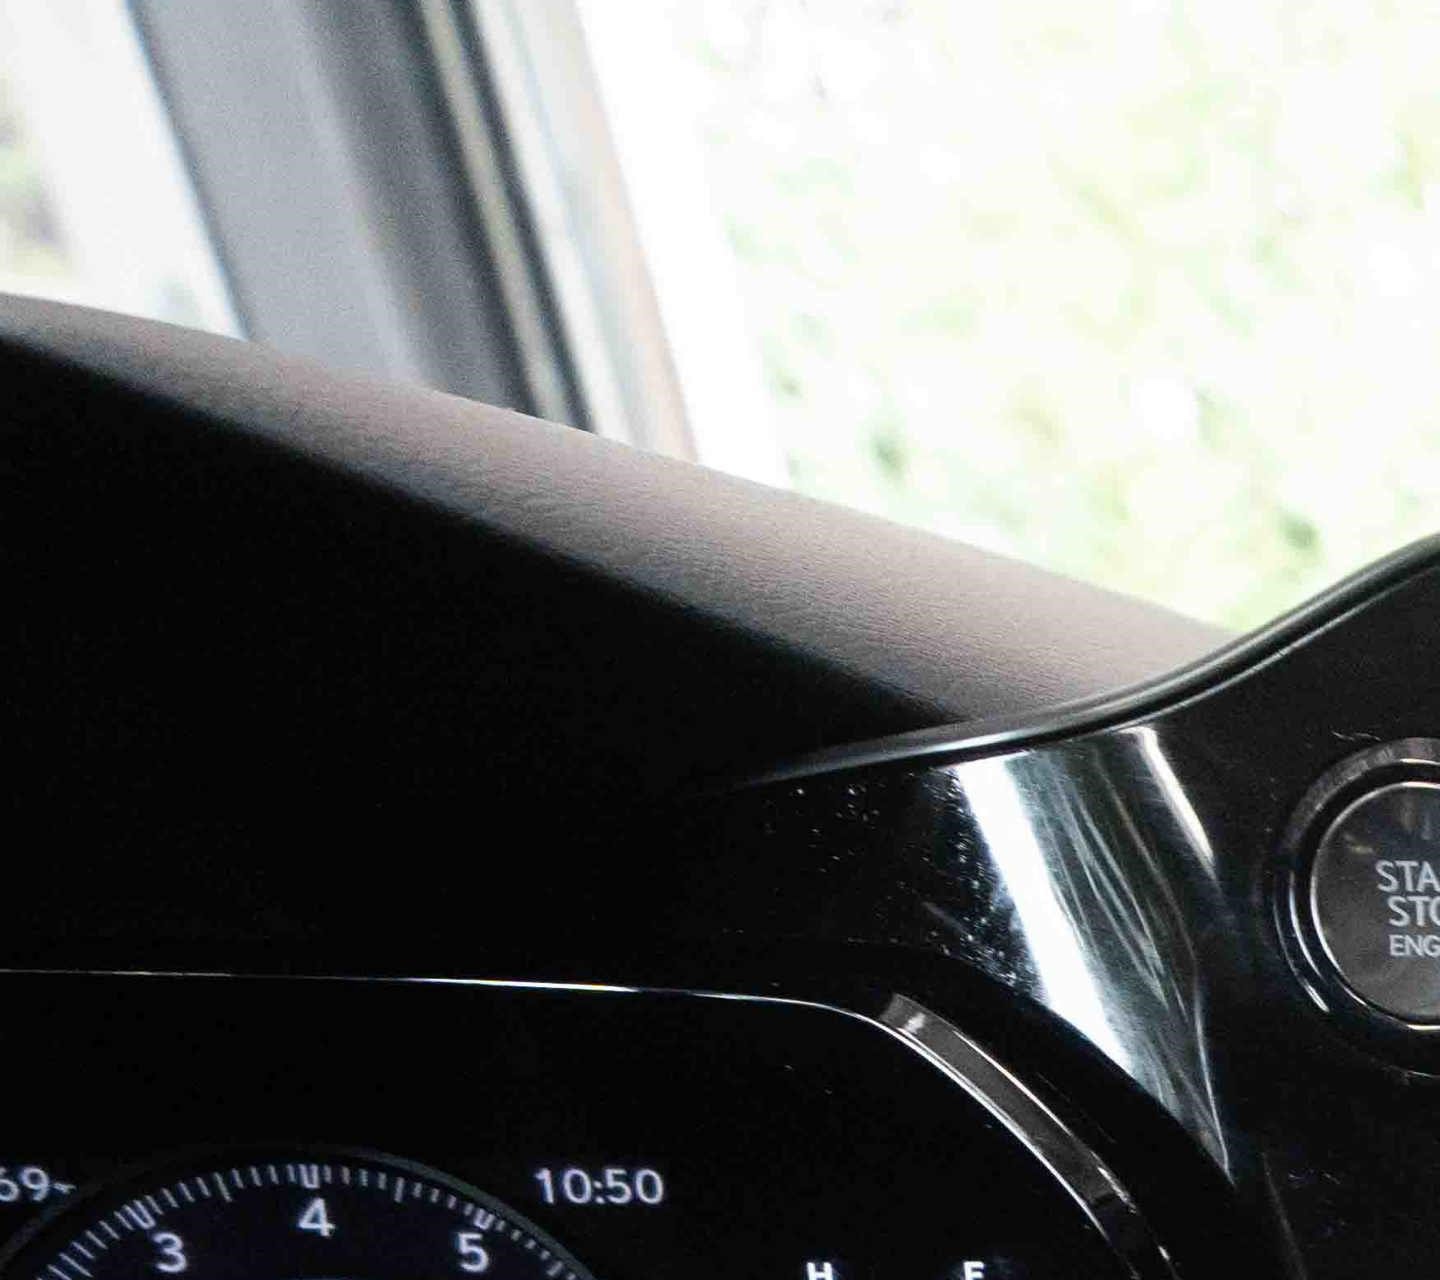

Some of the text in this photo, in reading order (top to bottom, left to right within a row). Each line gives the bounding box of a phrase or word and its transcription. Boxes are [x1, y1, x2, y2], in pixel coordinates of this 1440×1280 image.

[535, 1167, 664, 1205] 10:50
[297, 1197, 335, 1238] 4
[153, 1231, 187, 1273] 3
[457, 1232, 491, 1272] 5
